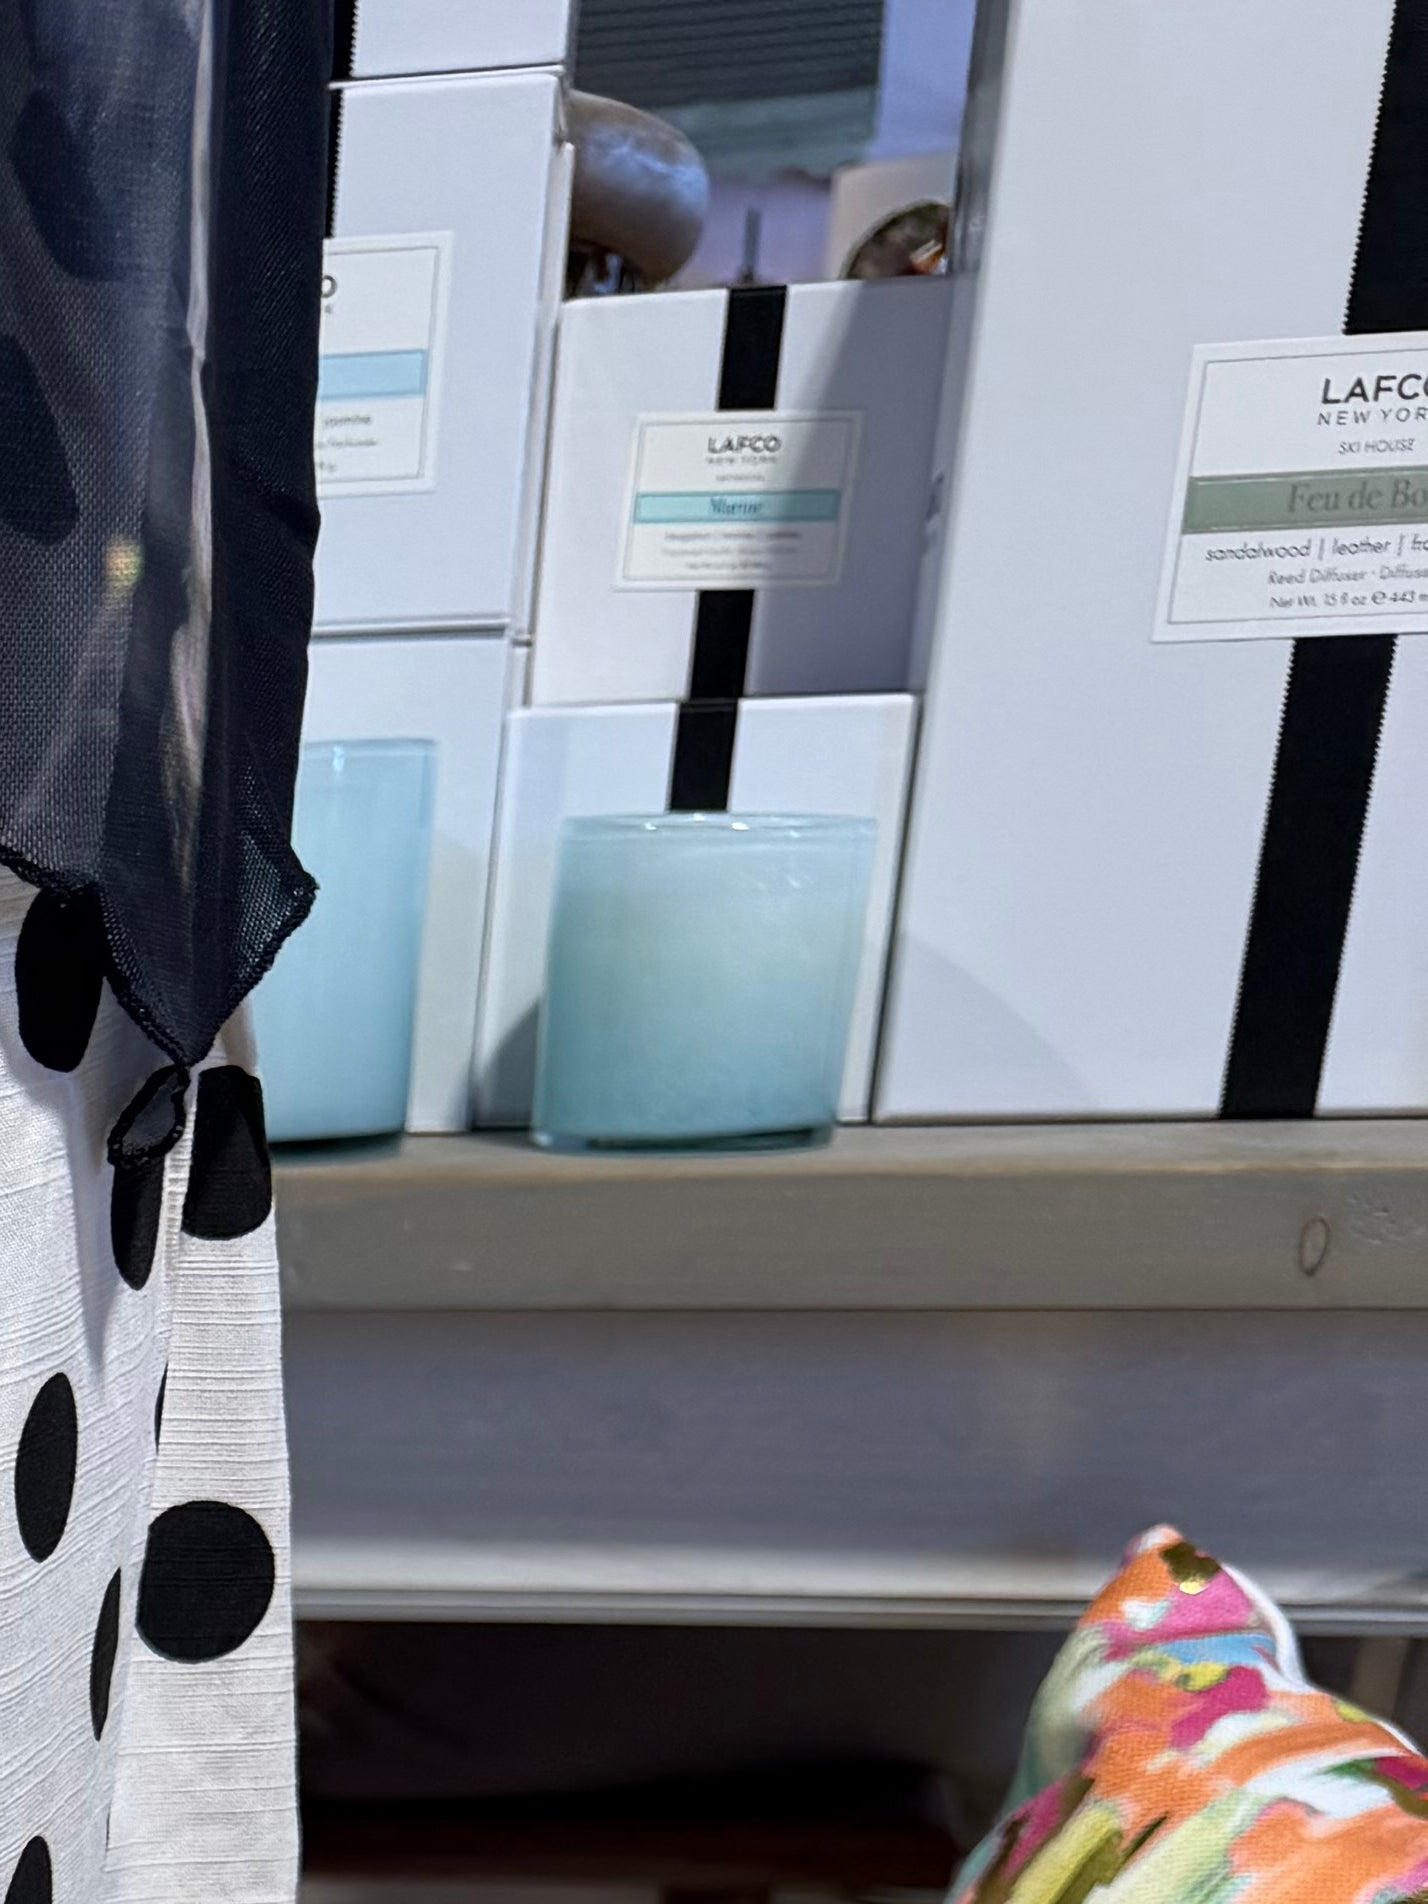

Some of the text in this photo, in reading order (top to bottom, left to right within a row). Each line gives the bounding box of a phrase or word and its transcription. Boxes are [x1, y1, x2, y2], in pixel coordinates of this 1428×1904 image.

[1321, 373, 1428, 404] LAFC
[1317, 410, 1371, 426] NEW
[707, 435, 782, 453] LAFCO
[1365, 438, 1415, 454] HOUSE
[1288, 482, 1340, 513] Feu
[1347, 480, 1383, 511] de
[1205, 538, 1312, 561] sandalwood
[1334, 536, 1391, 556] leather
